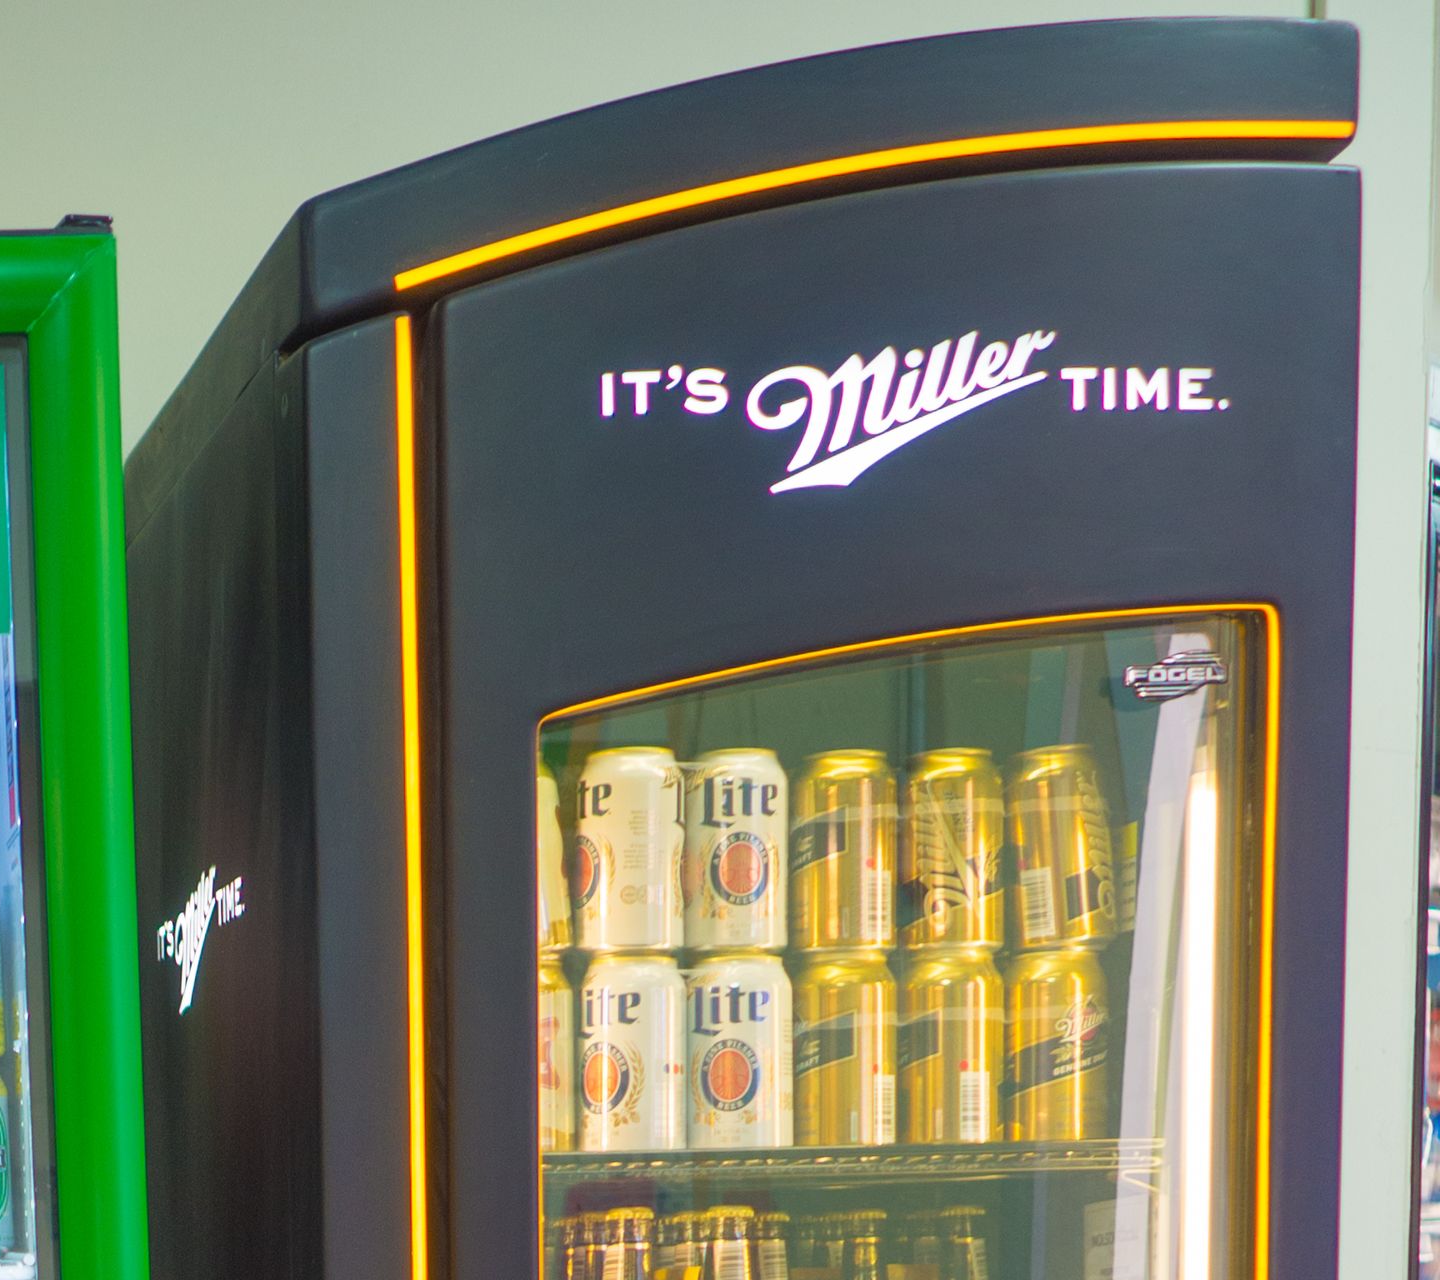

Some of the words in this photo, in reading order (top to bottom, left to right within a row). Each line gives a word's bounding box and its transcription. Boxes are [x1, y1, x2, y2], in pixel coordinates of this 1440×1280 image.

[600, 364, 728, 416] IT'S
[746, 330, 1057, 493] Miller
[1061, 367, 1229, 411] TIME.
[701, 777, 778, 829] Lite
[174, 865, 216, 1015] Miller
[692, 984, 770, 1037] Lite
